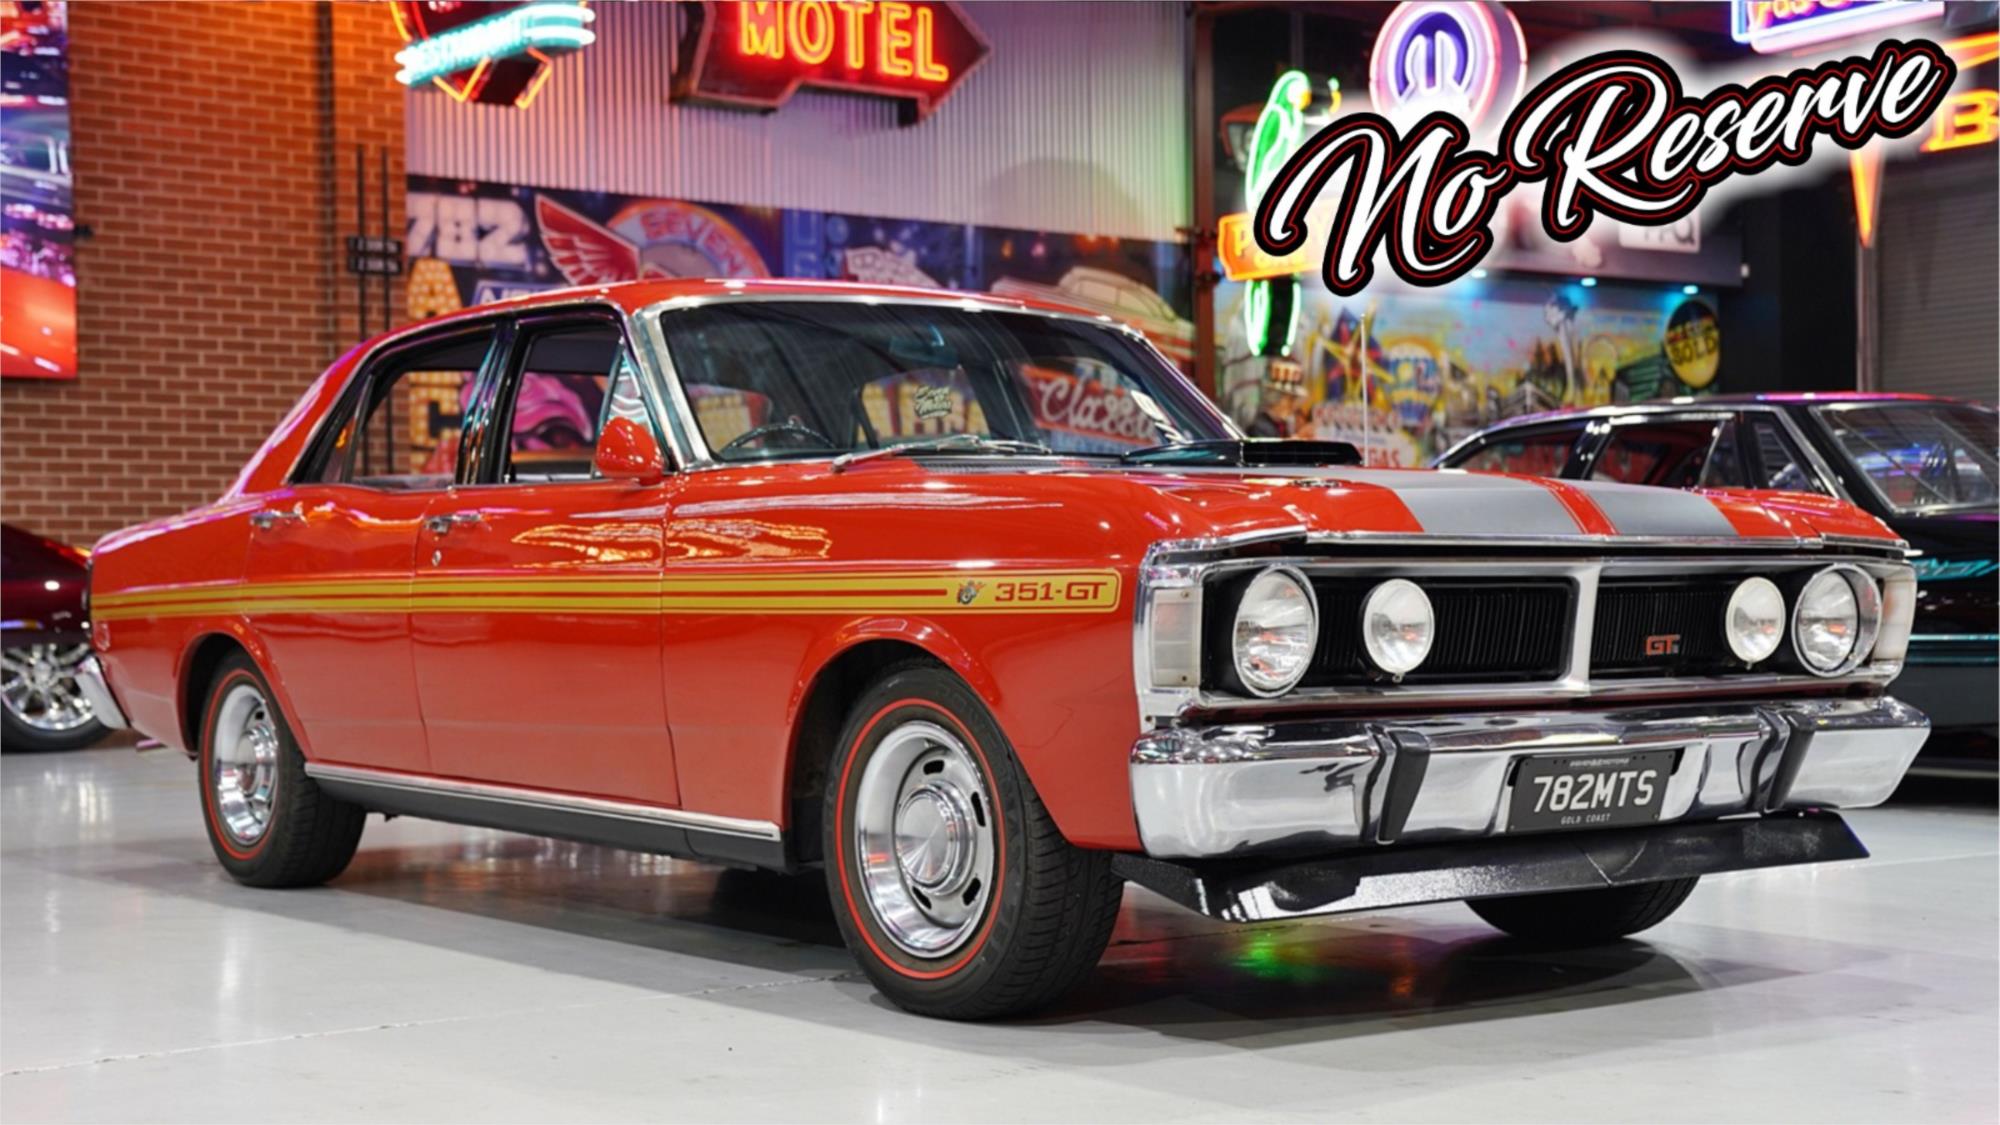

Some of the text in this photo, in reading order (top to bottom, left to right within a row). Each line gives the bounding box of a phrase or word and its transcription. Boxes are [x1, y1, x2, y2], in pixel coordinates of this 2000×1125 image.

[740, 0, 949, 83] MOTEL
[995, 582, 1107, 602] 351-GT
[1646, 634, 1681, 655] GT
[1533, 769, 1658, 813] 782MTS
[1560, 813, 1612, 825] GOLD COAST
